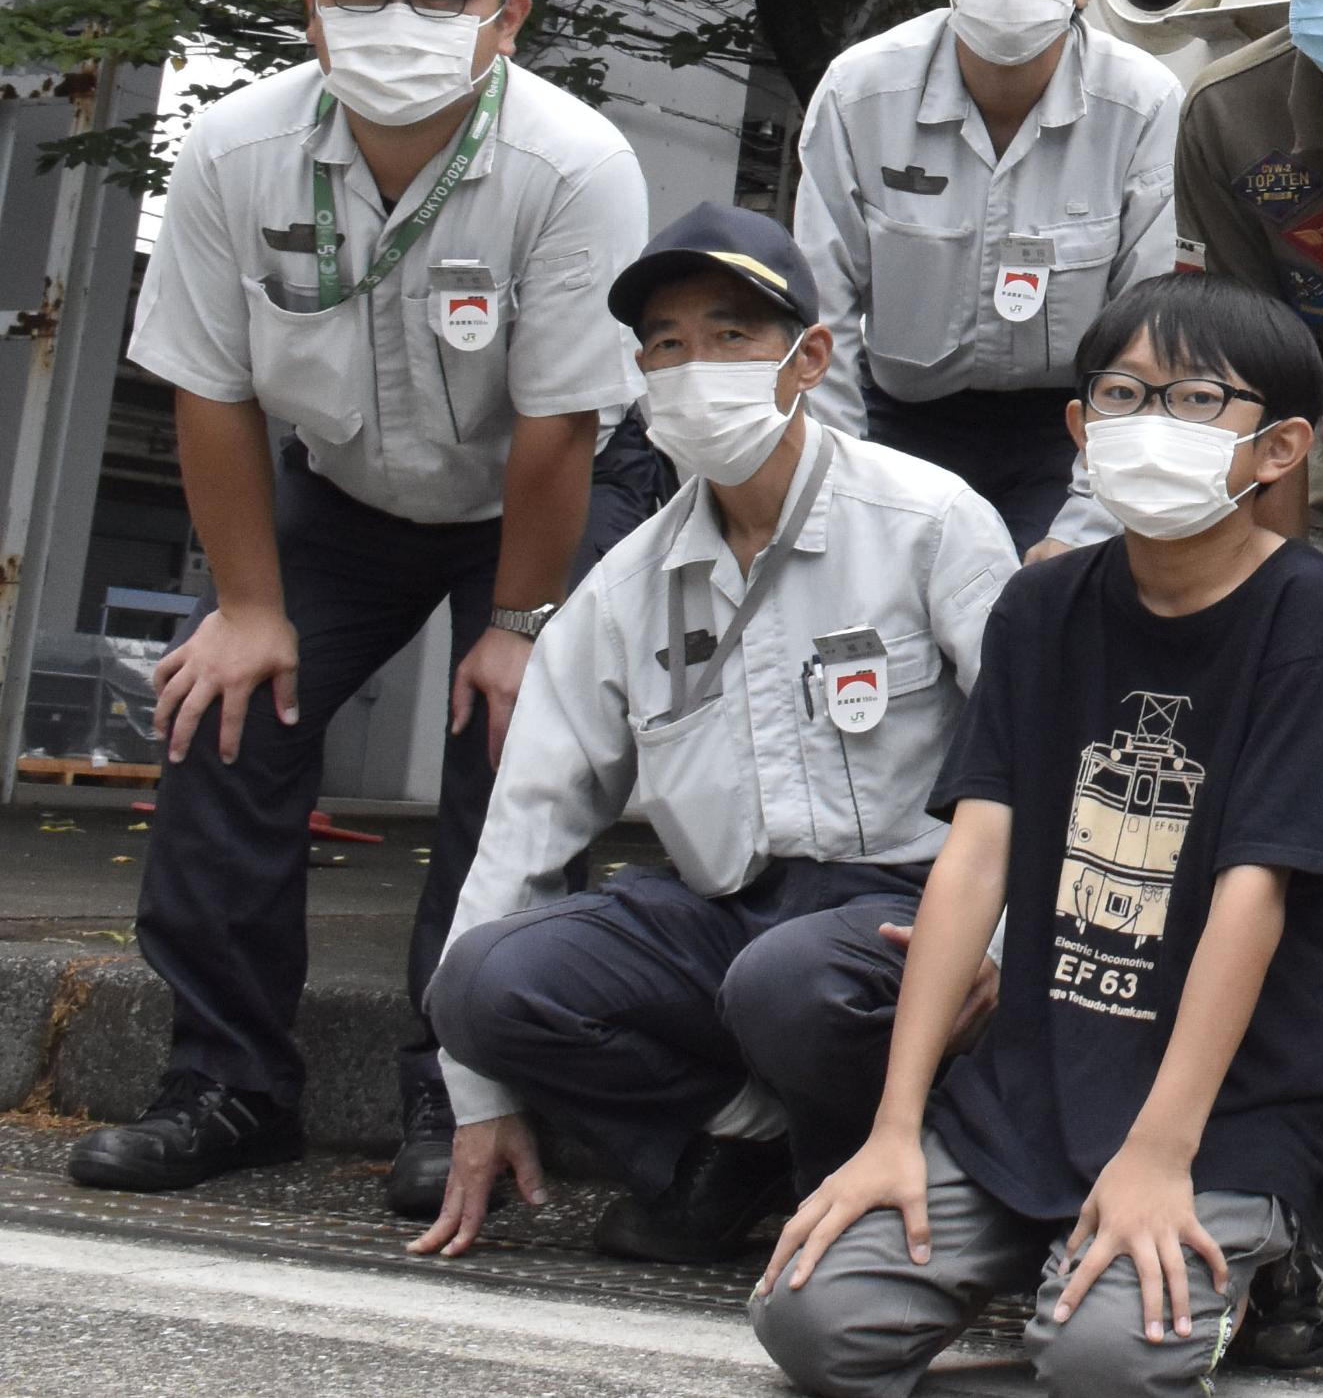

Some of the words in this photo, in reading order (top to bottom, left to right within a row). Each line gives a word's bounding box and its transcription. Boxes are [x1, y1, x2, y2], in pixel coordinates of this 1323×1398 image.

[412, 186, 448, 226] TOKYO
[442, 154, 469, 188] 2020
[1245, 174, 1275, 189] TOP
[1278, 172, 1310, 187] TEN
[317, 244, 337, 255] JR
[850, 711, 865, 722] JR
[1054, 936, 1093, 956] Electric
[1094, 948, 1155, 971] Locomotive
[1054, 953, 1097, 986] EF
[1099, 969, 1138, 999] 63
